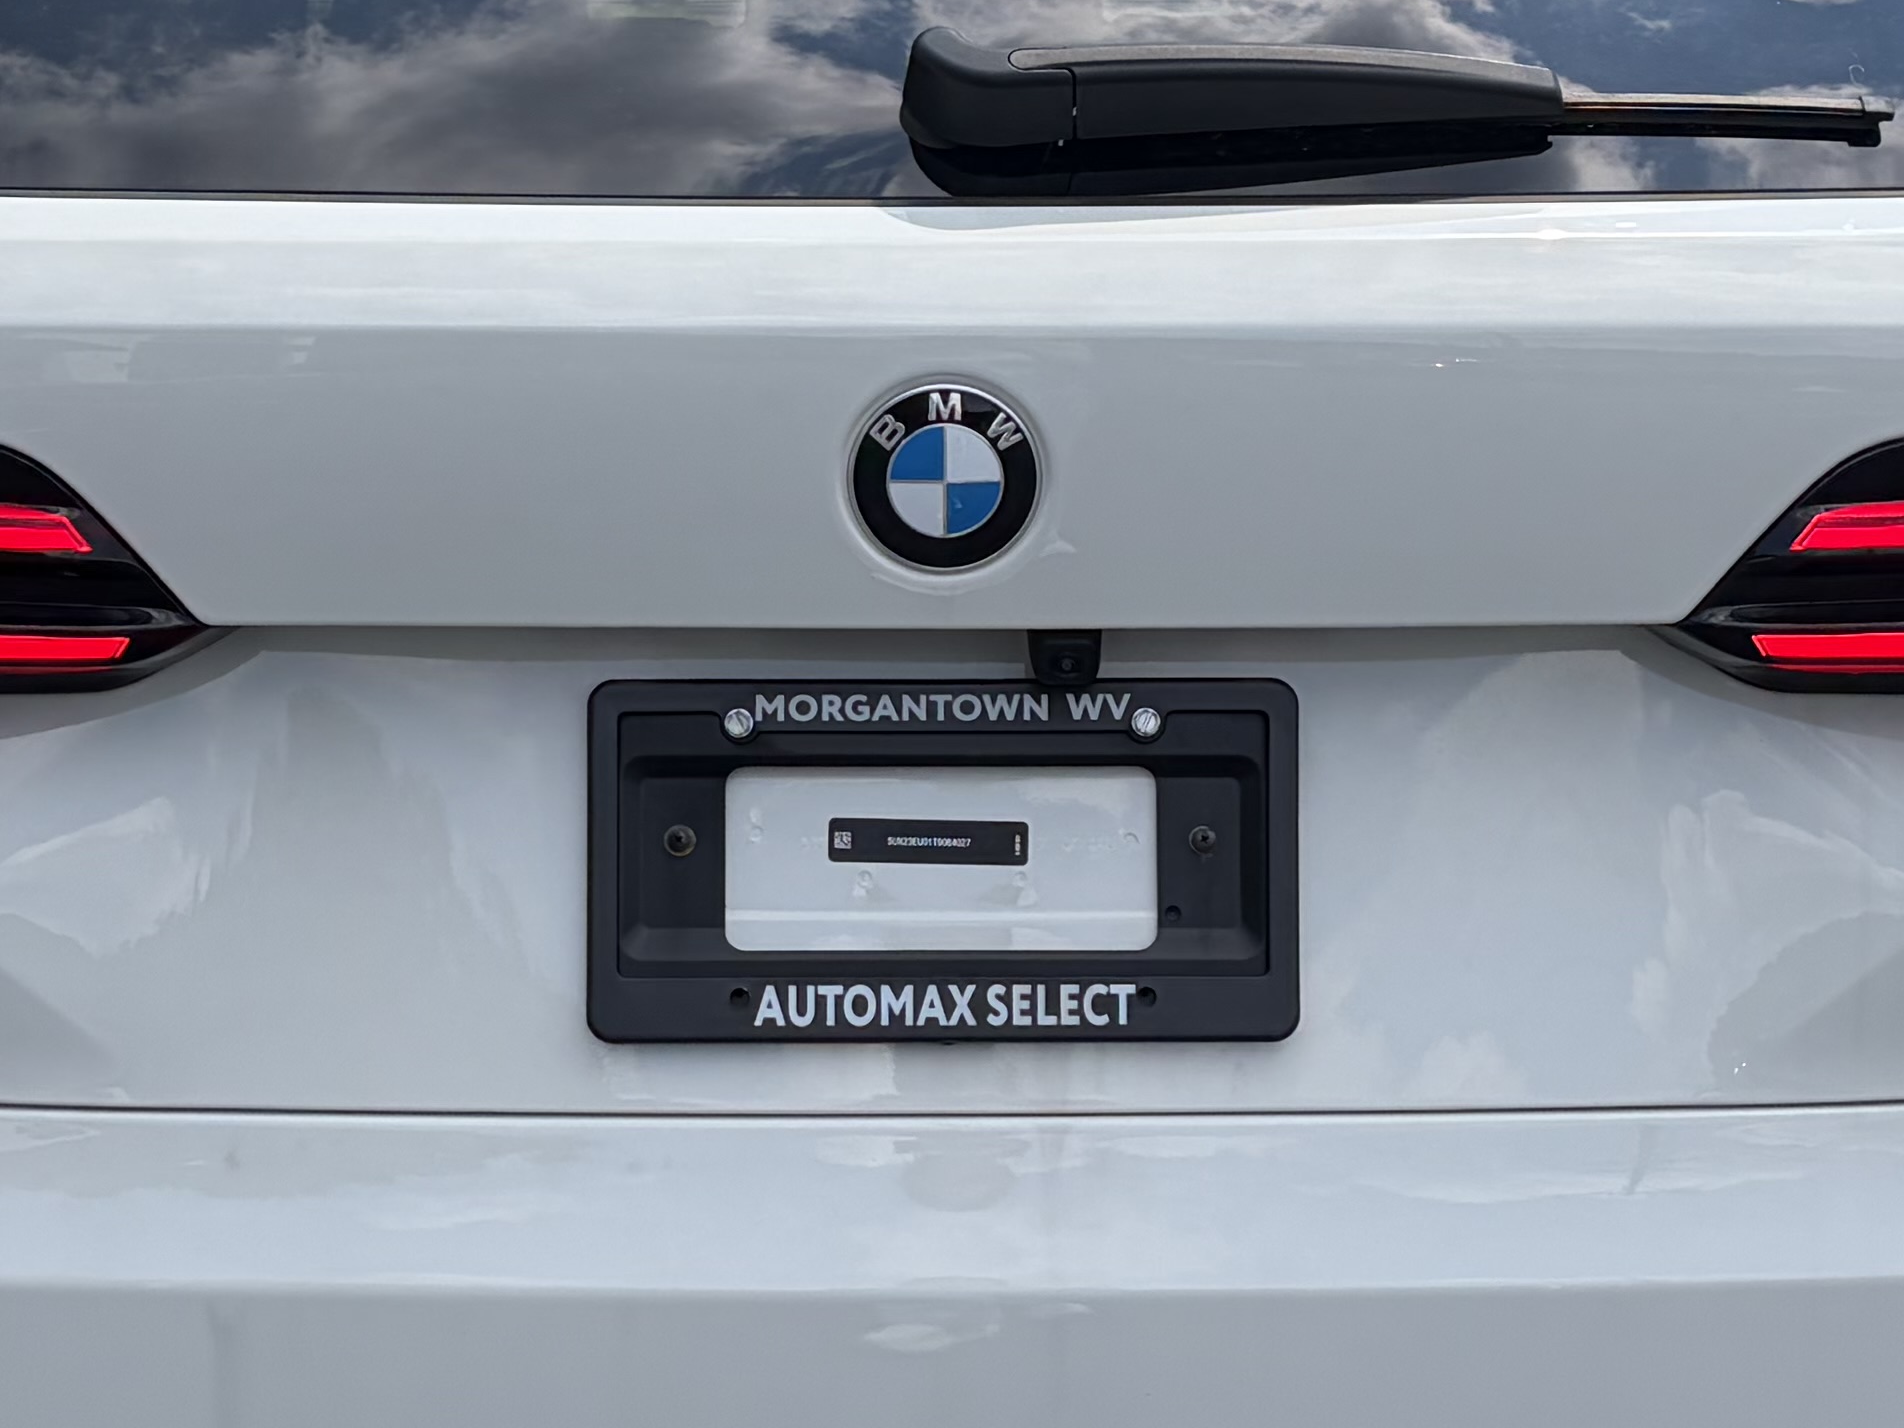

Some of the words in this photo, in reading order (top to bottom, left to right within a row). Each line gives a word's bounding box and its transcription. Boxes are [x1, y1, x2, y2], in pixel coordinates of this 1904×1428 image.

[869, 391, 1024, 452] BMW
[754, 692, 1050, 723] MORGANTOWN
[1065, 692, 1132, 722] WV
[753, 984, 978, 1027] AUTOMAX
[986, 983, 1137, 1026] SELECT
